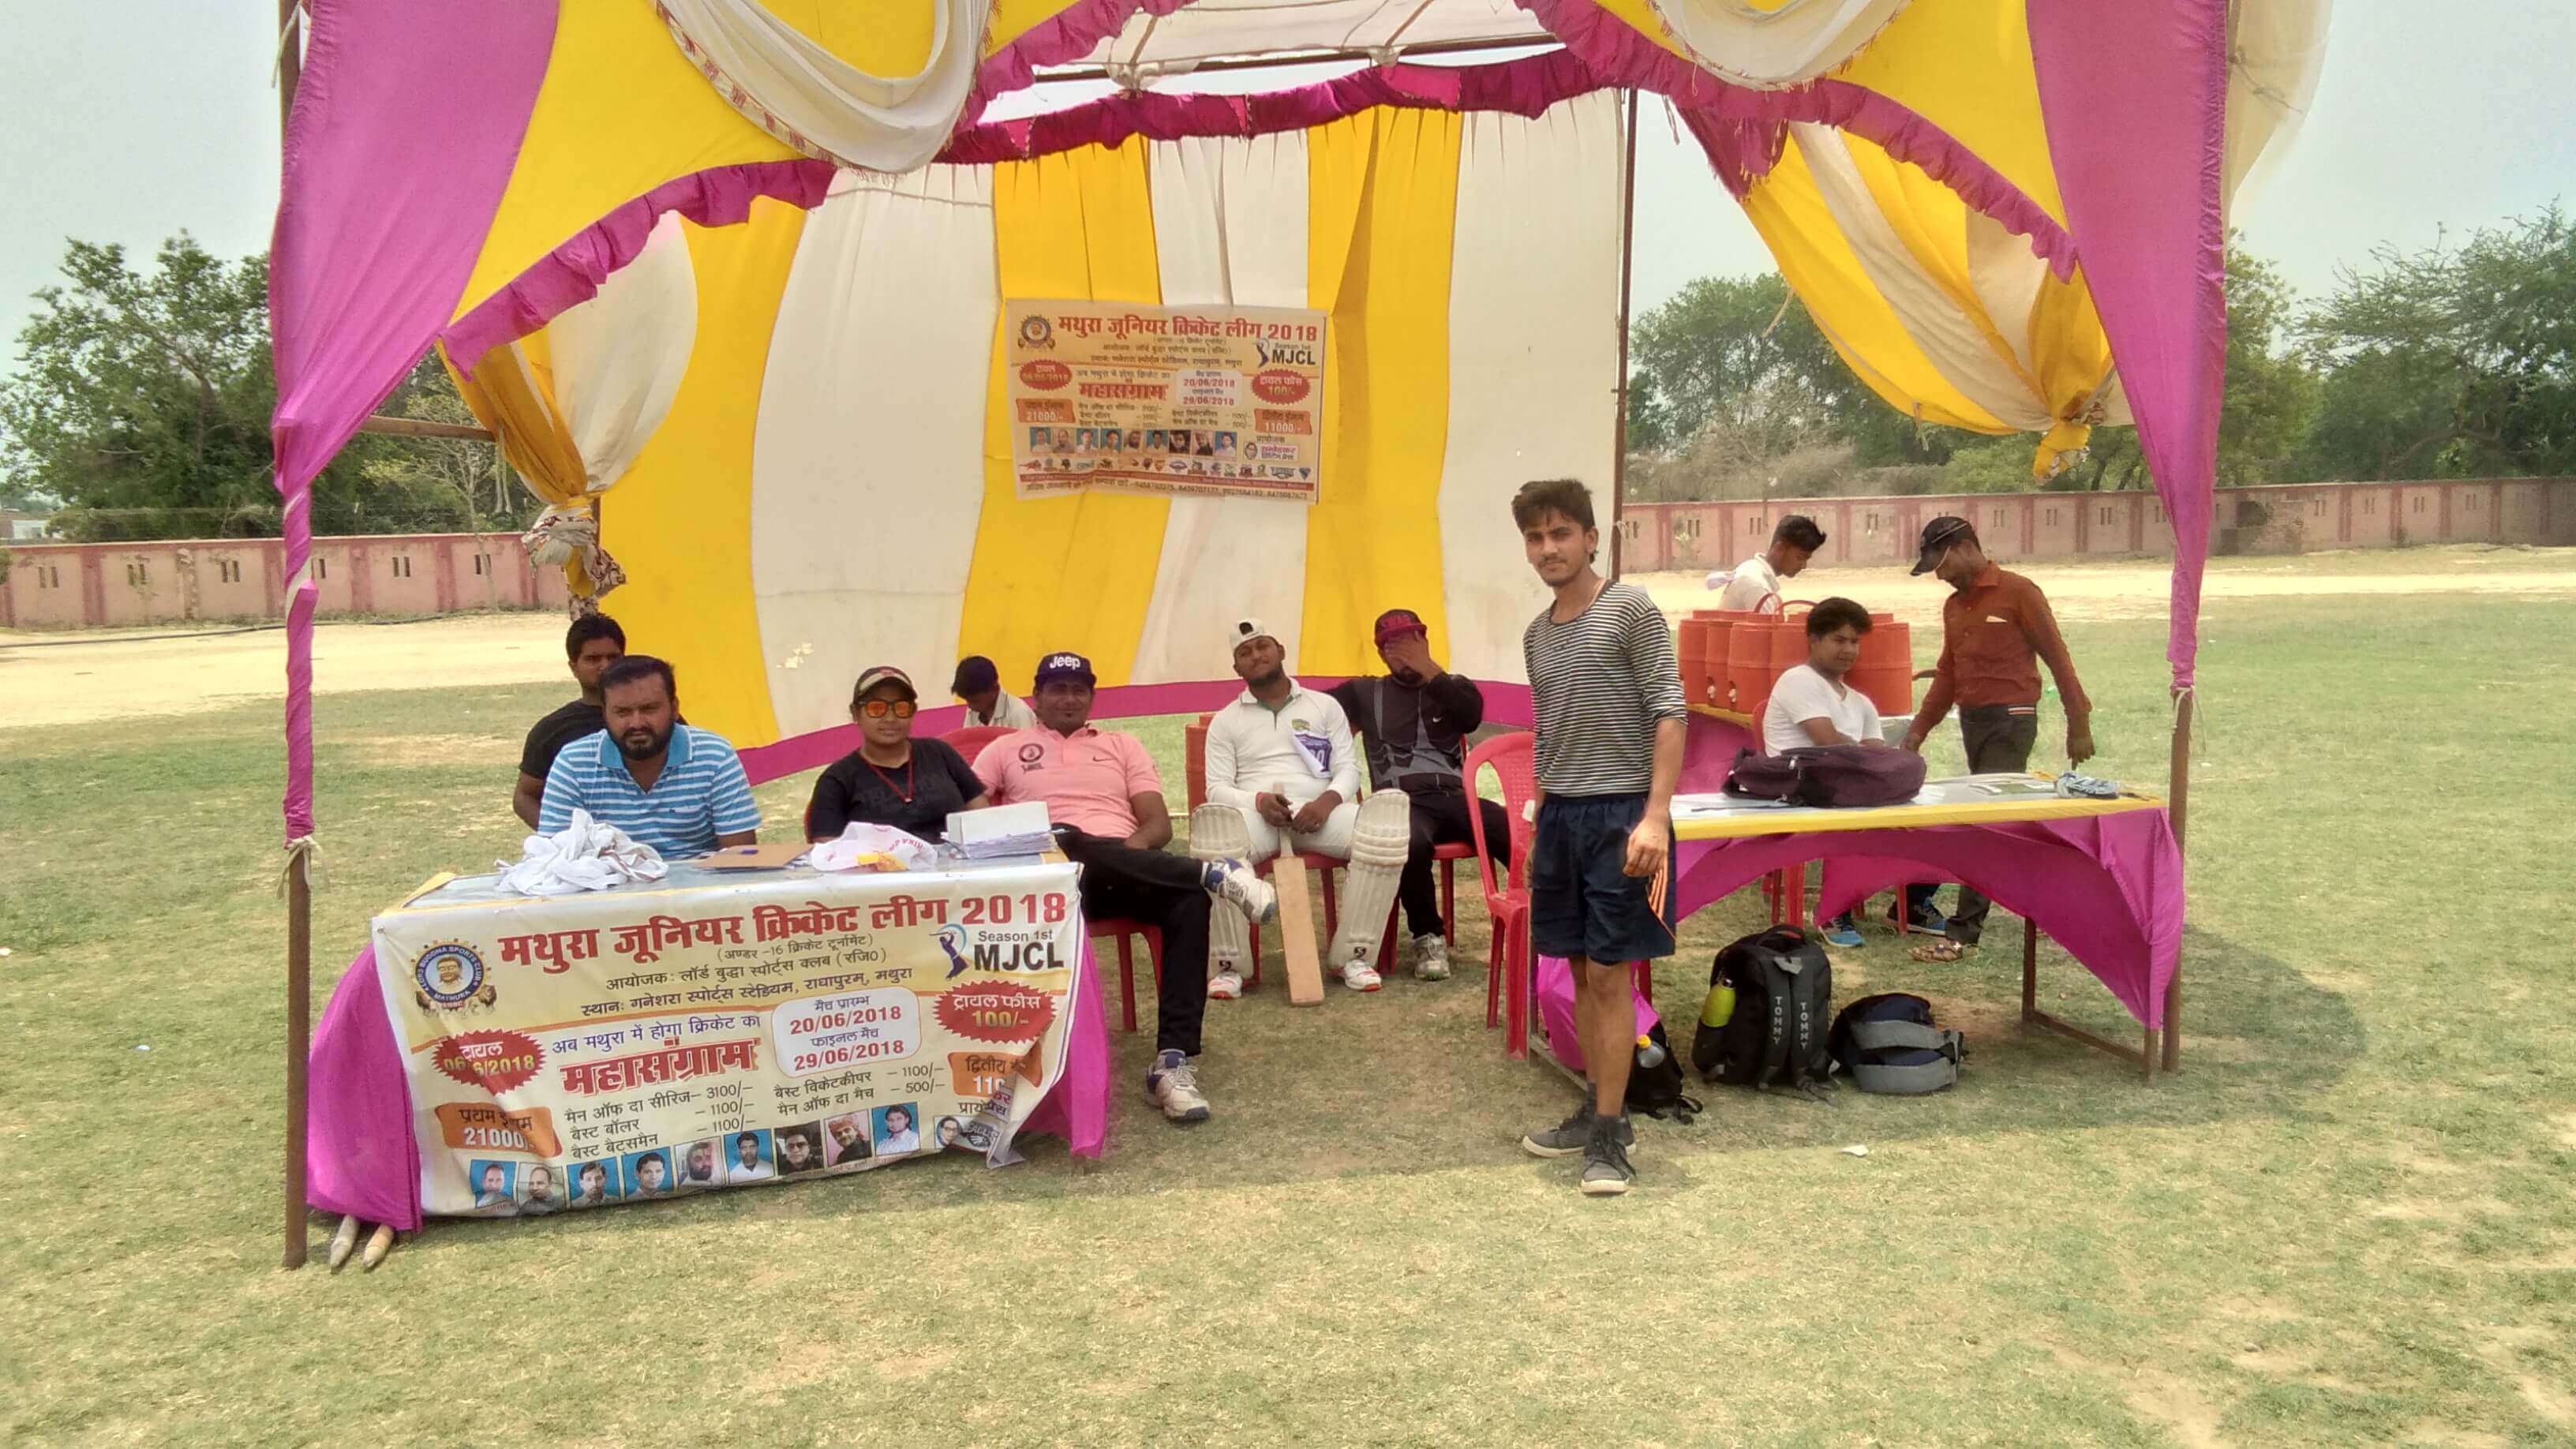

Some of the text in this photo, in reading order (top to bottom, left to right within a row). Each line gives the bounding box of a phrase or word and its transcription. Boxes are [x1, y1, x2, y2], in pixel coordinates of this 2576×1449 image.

[1058, 314, 1317, 341] मथुरा जूनियर क्रिकेट लीग 2018
[1272, 350, 1316, 365] MJCL
[1050, 656, 1080, 670] Jeep
[497, 893, 1065, 973] मथुरा जूनियर क्रिकेट लीग 2018
[788, 938, 822, 953] क्रिकेट
[979, 930, 1053, 942] Season 1st
[679, 964, 710, 982] लॉर्ड
[716, 966, 744, 982] बुद्धा
[800, 956, 830, 968] क्लब
[974, 942, 1064, 972] MJCL
[630, 993, 681, 1009] गनेशरा
[875, 968, 912, 983] मथुरा
[953, 992, 1042, 1011] ट्रायल फीस
[814, 999, 833, 1011] मैच
[790, 1006, 901, 1035] 20/06/2018
[972, 1011, 1029, 1028] 100/-
[1773, 996, 1783, 1045] TOMMY
[1799, 1002, 1809, 1050] TOMMY
[552, 1015, 762, 1054] अब मथुरा में होगा क्रिकेट का
[811, 1028, 879, 1048] फाइनल मैच
[560, 1036, 762, 1096] महासंग्राम
[794, 1040, 904, 1071] 29/06/2018
[773, 1084, 800, 1099] बैस्ट
[805, 1071, 872, 1094] विकेटकीपर
[565, 1109, 587, 1123] मैन
[593, 1102, 623, 1119] ऑफ
[629, 1099, 644, 1112] दा
[777, 1102, 798, 1116] मैन
[803, 1096, 829, 1112] ऑफ
[834, 1093, 849, 1105] दा
[853, 1087, 874, 1100] मैच
[459, 1108, 496, 1124] प्रथम
[571, 1125, 600, 1141] बैस्ट
[605, 1118, 640, 1136] बॉलर
[572, 1143, 601, 1159] बैस्ट
